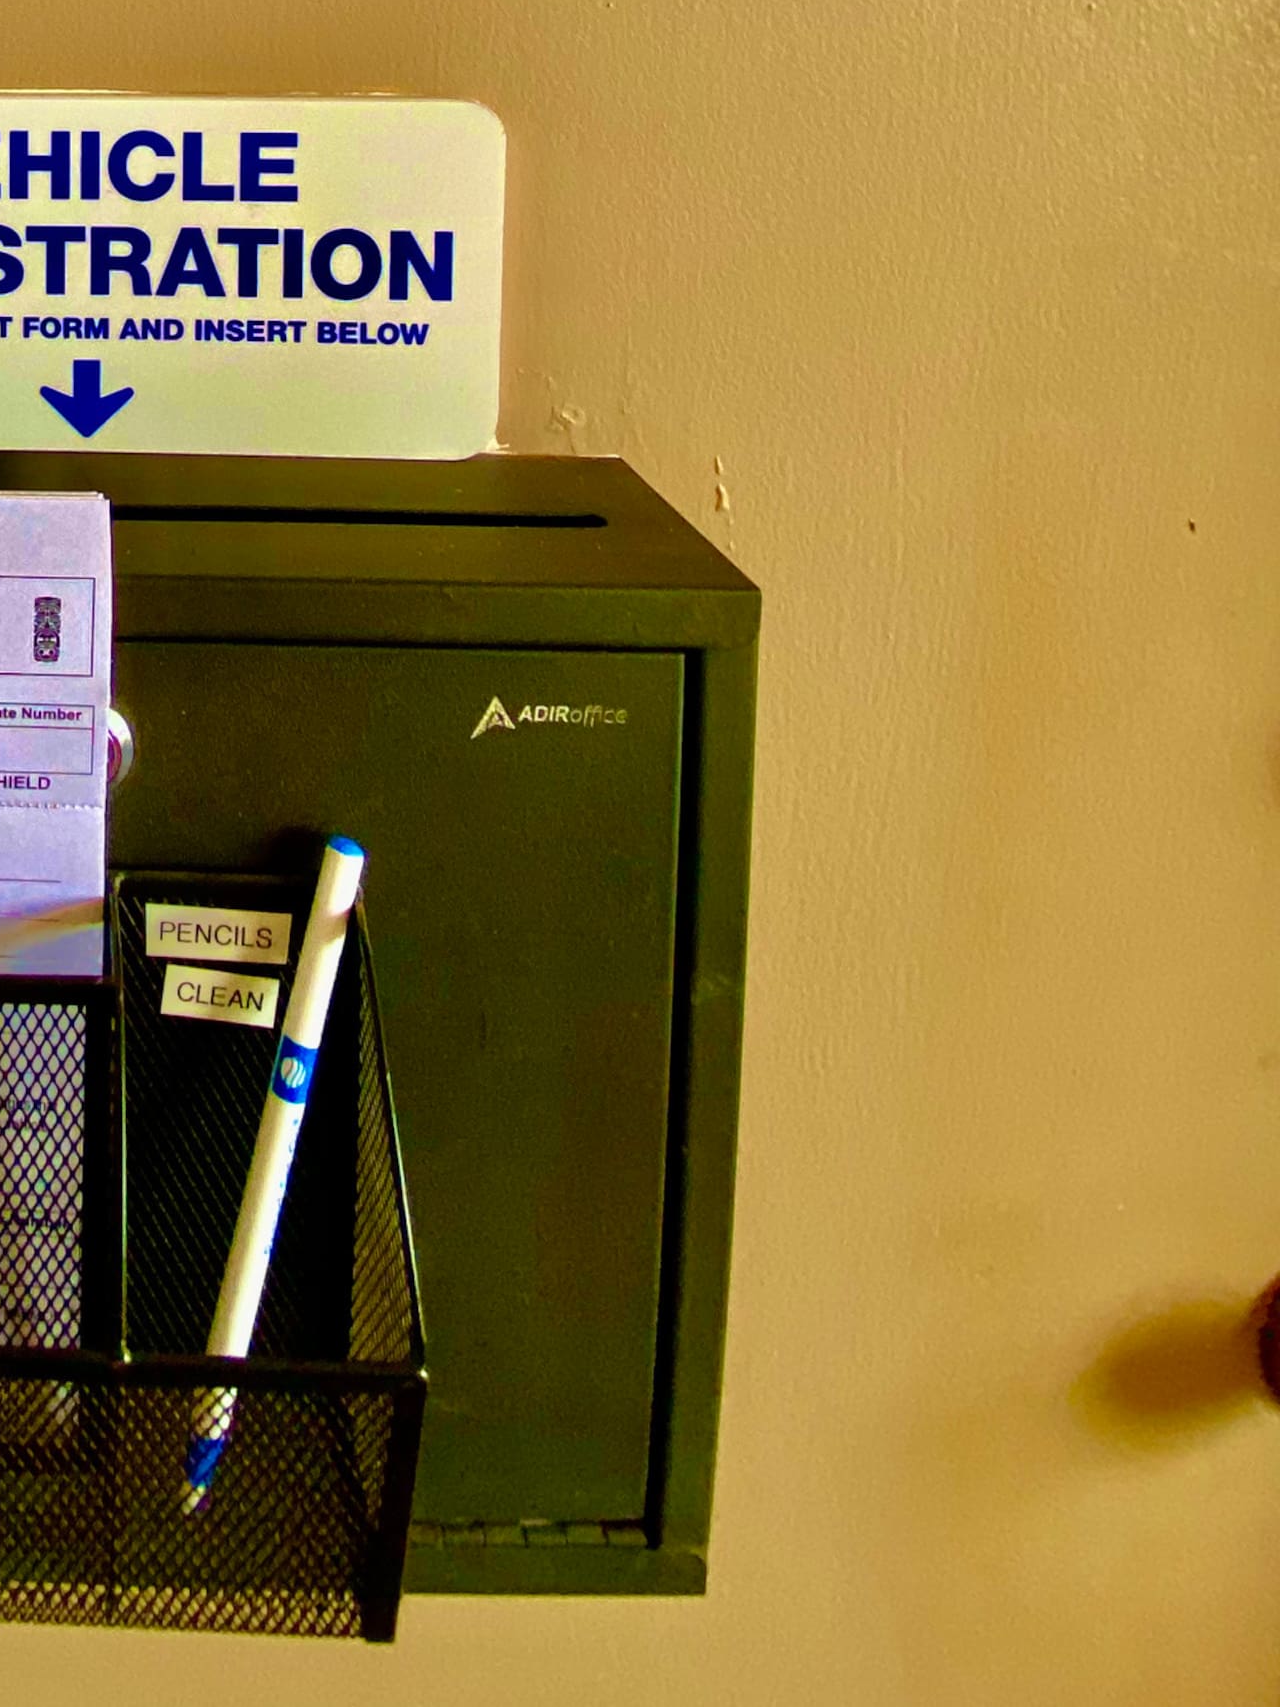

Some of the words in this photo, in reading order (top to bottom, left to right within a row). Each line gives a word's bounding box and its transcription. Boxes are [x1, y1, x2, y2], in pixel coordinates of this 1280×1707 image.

[23, 317, 109, 340] FORM
[119, 318, 184, 341] AND
[195, 319, 307, 343] INSERT
[317, 321, 430, 345] BELOW
[22, 707, 83, 722] Number
[518, 703, 628, 727] ADIRoffice
[159, 921, 273, 950] PENCILS
[177, 982, 264, 1012] CLEAN
